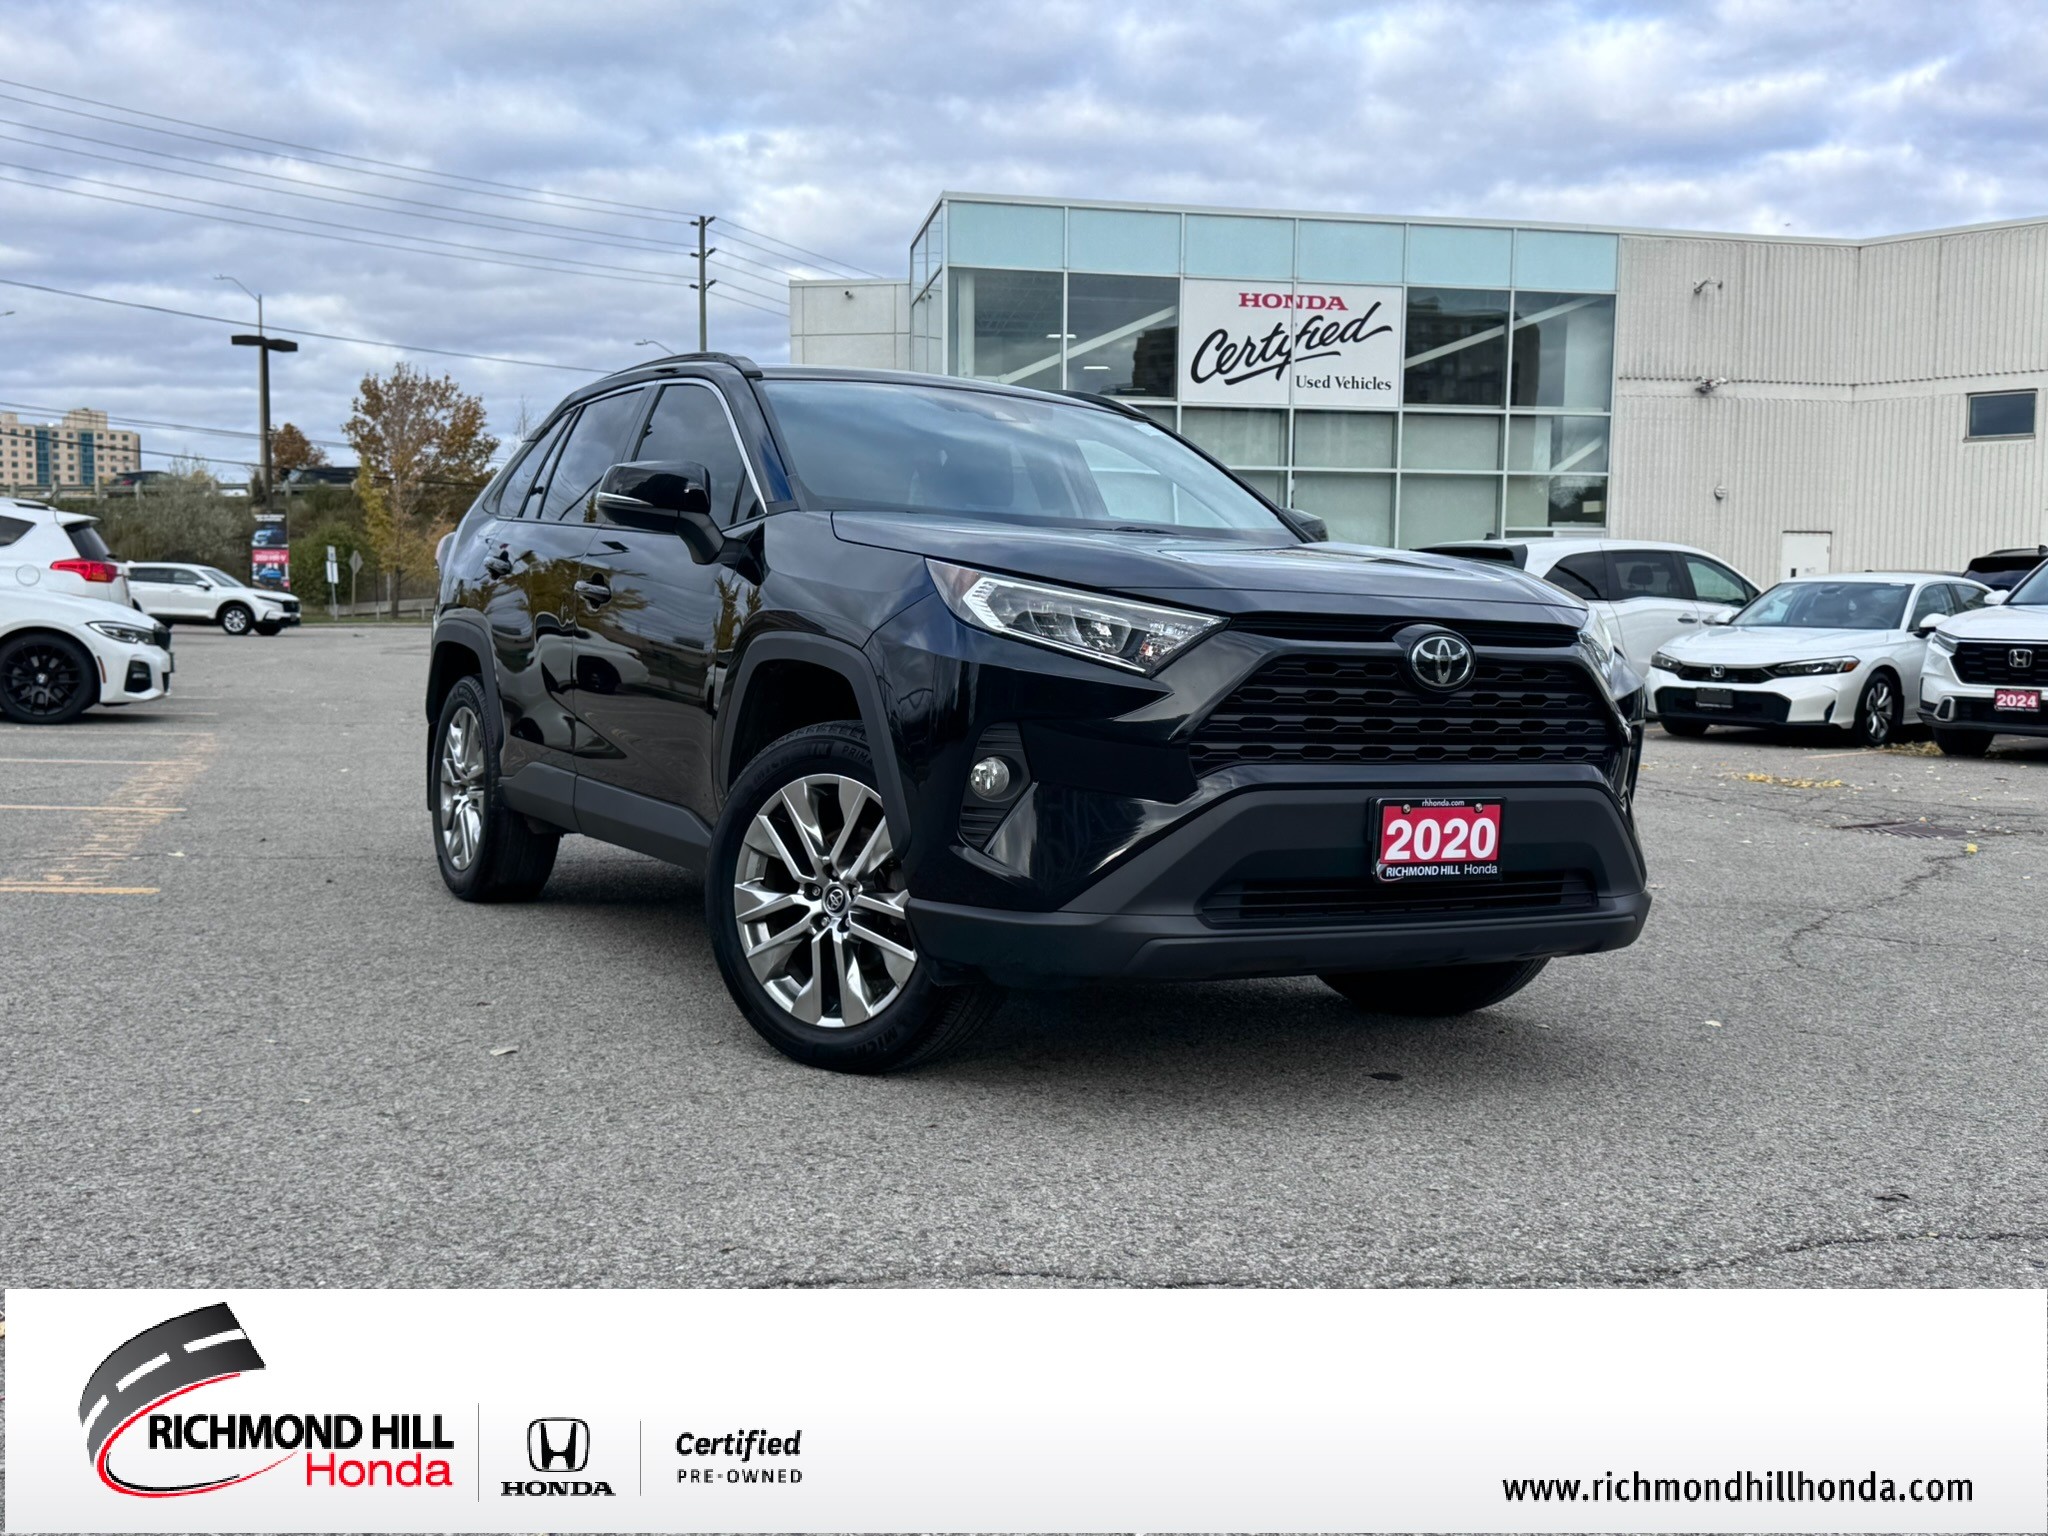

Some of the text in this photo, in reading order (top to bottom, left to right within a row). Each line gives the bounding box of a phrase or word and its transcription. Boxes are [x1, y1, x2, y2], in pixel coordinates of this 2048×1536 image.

[1238, 293, 1348, 311] HONDA
[1191, 301, 1393, 385] Certified
[1296, 375, 1392, 390] Used Vehicles
[1996, 694, 2038, 708] 2024
[1421, 798, 1465, 807] rhhonda.com
[1384, 817, 1497, 860] 2020
[1385, 863, 1498, 877] RICHMOND HILL Honda
